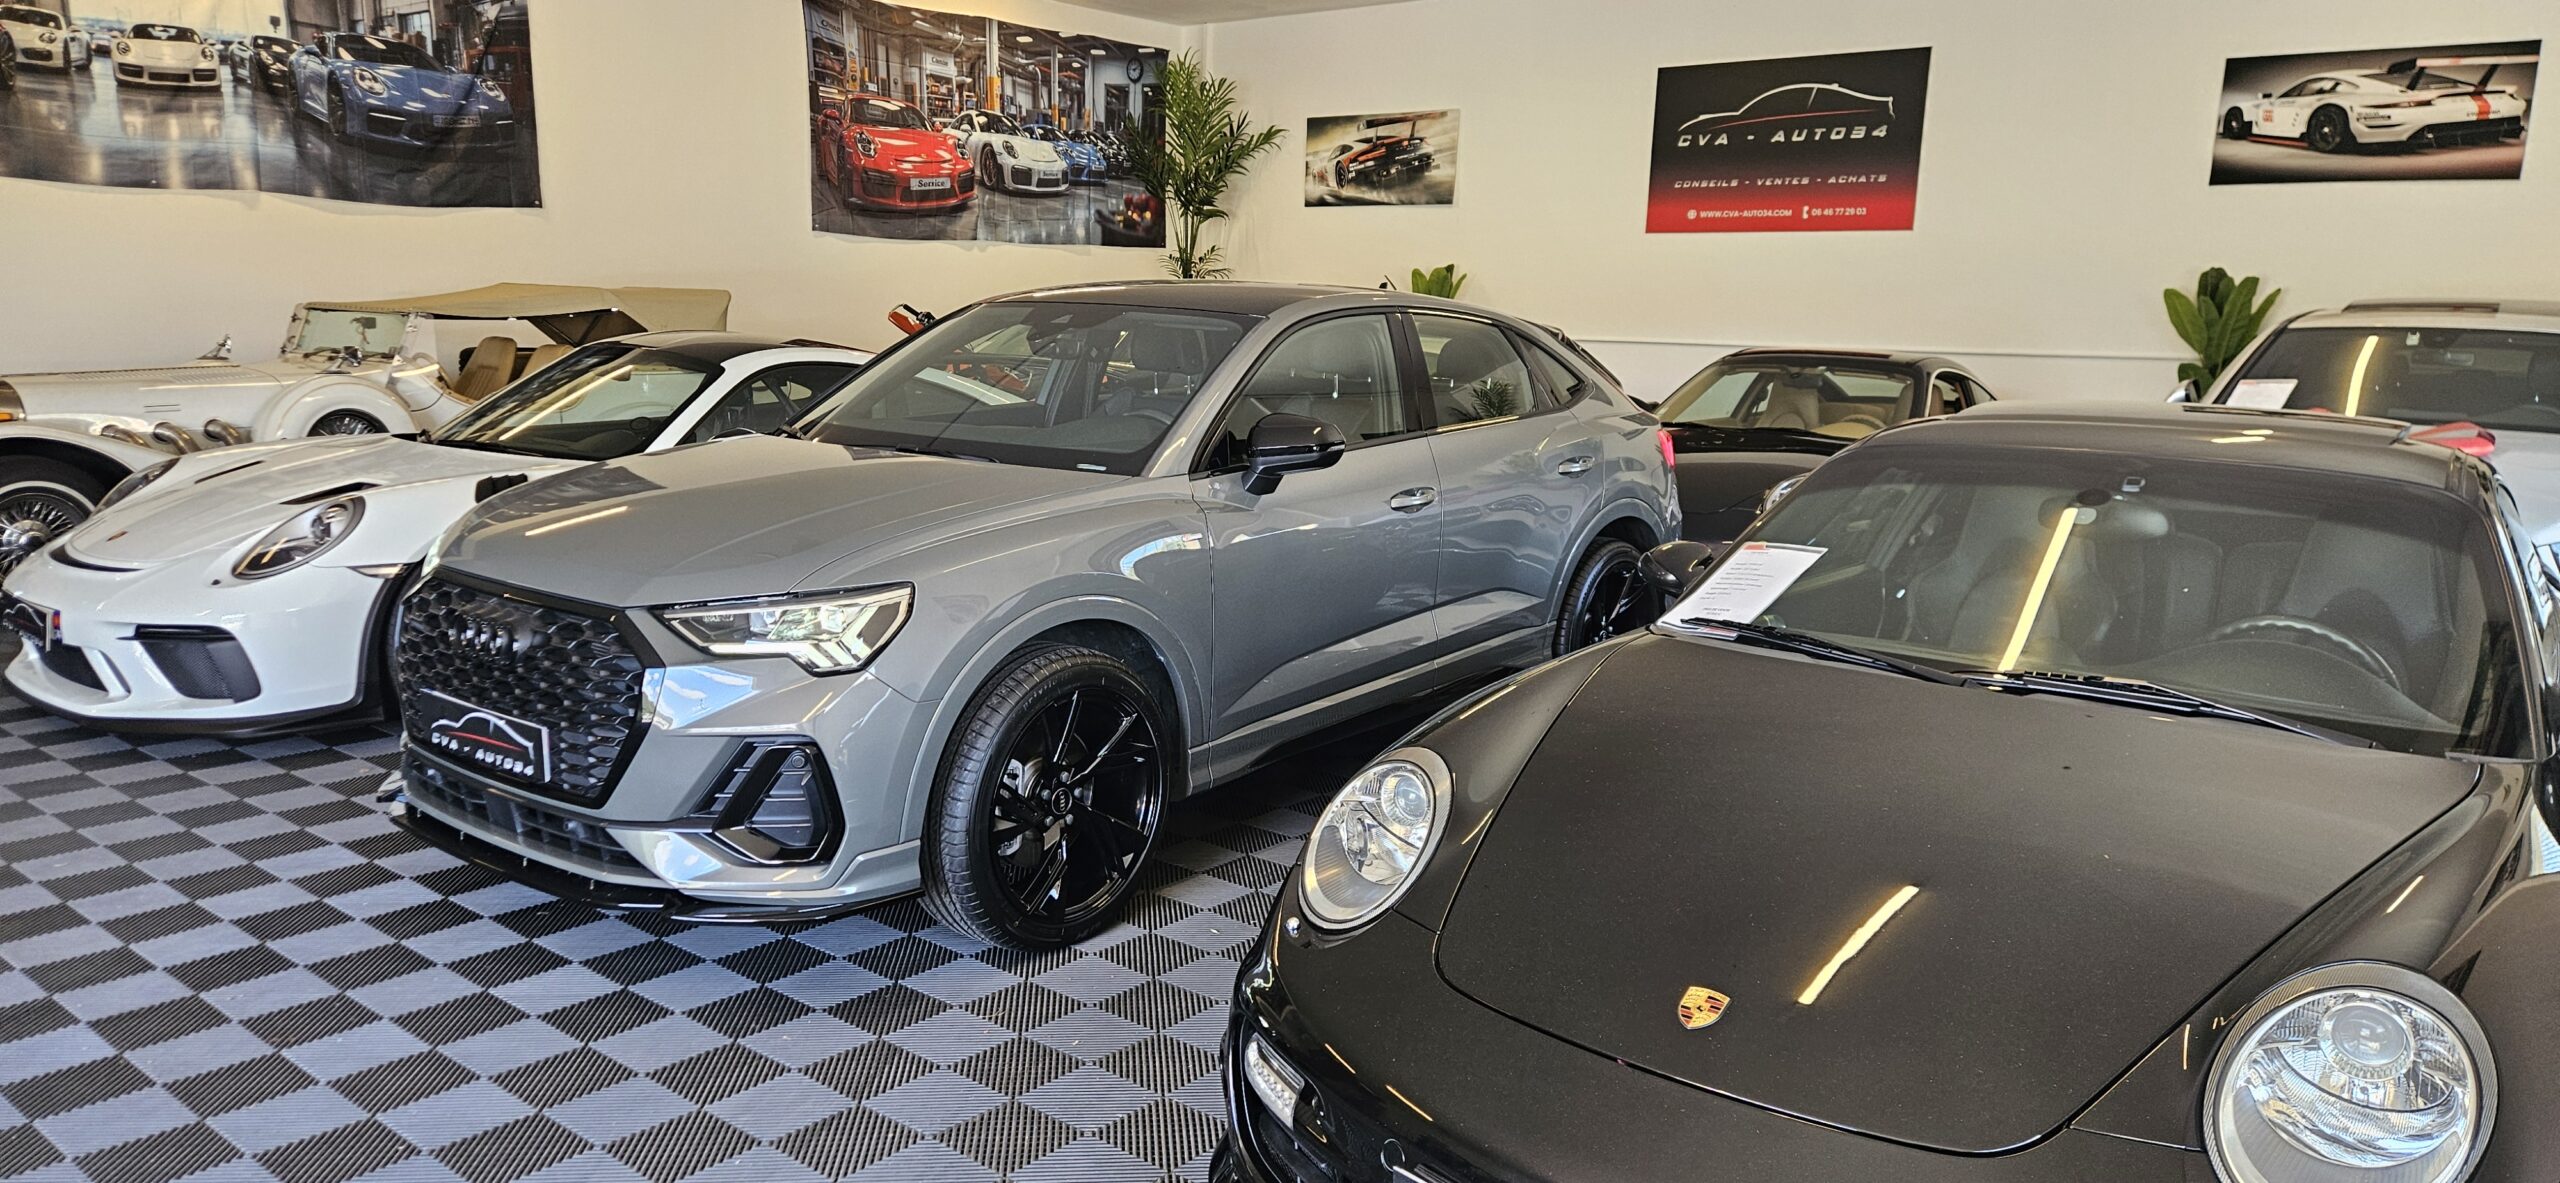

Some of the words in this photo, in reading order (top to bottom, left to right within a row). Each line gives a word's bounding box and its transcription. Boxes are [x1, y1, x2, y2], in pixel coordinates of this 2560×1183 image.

[1677, 133, 1728, 147] CVA
[1770, 124, 1888, 143] AUTO34
[1674, 178, 1739, 189] CONSEILS
[1757, 176, 1810, 186] VENTES
[1827, 174, 1887, 184] ACHATS
[1699, 208, 1793, 218] WWW.CVA-AUTO34.COM
[1834, 207, 1845, 216] 77
[431, 732, 459, 750] CVA
[475, 748, 535, 777] AUTO34
